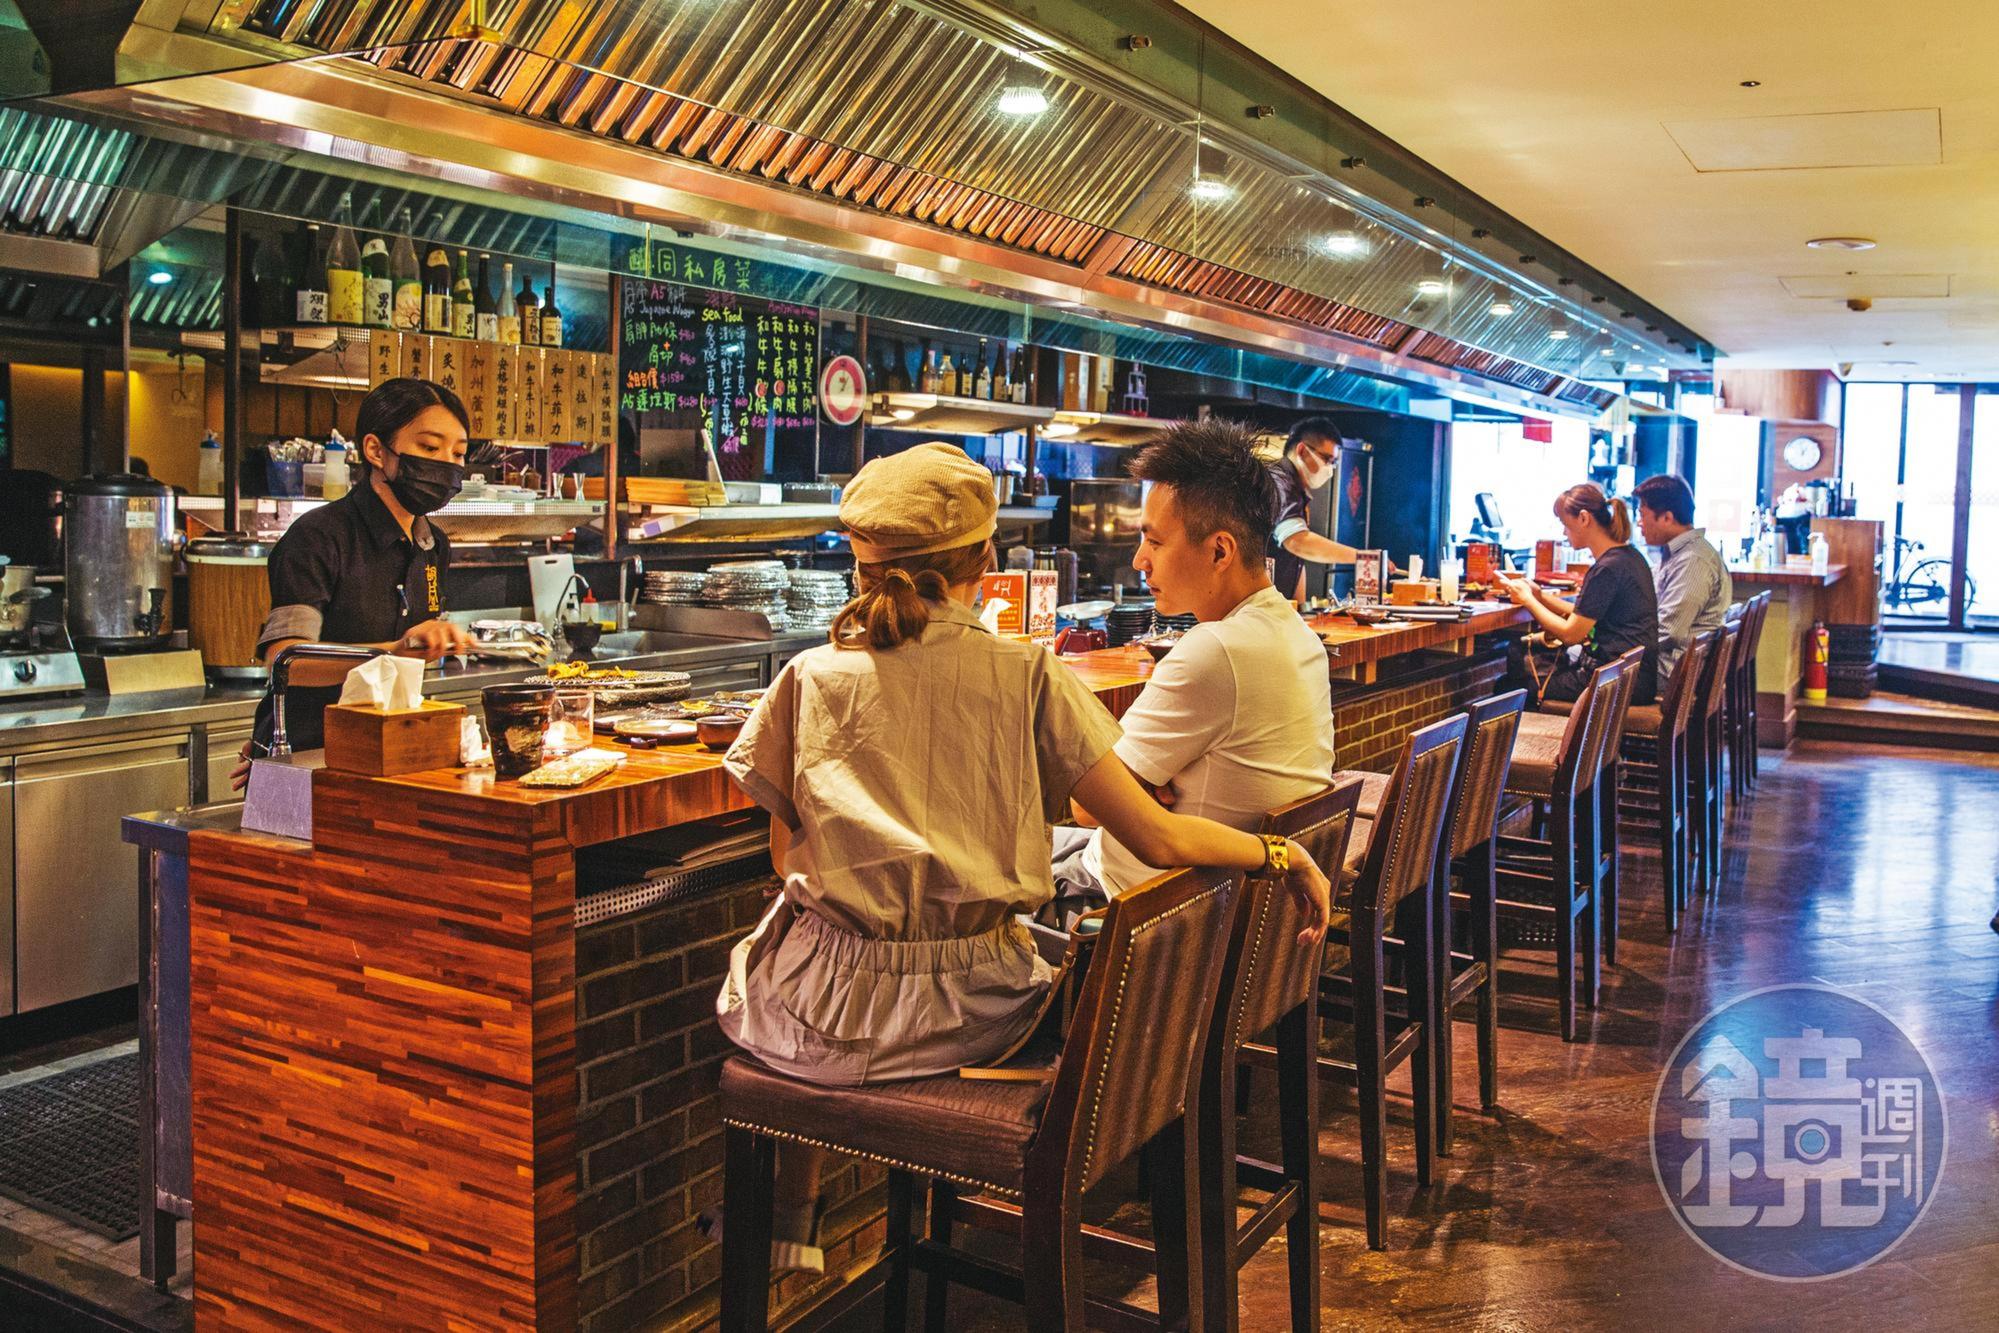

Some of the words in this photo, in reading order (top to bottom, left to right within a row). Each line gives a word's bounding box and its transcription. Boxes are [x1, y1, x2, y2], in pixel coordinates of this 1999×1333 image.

[379, 345, 391, 381] 野生
[470, 354, 485, 434] 加州蘆筍
[525, 361, 535, 436] 和牛牛小排
[551, 363, 564, 436] 和牛菲力
